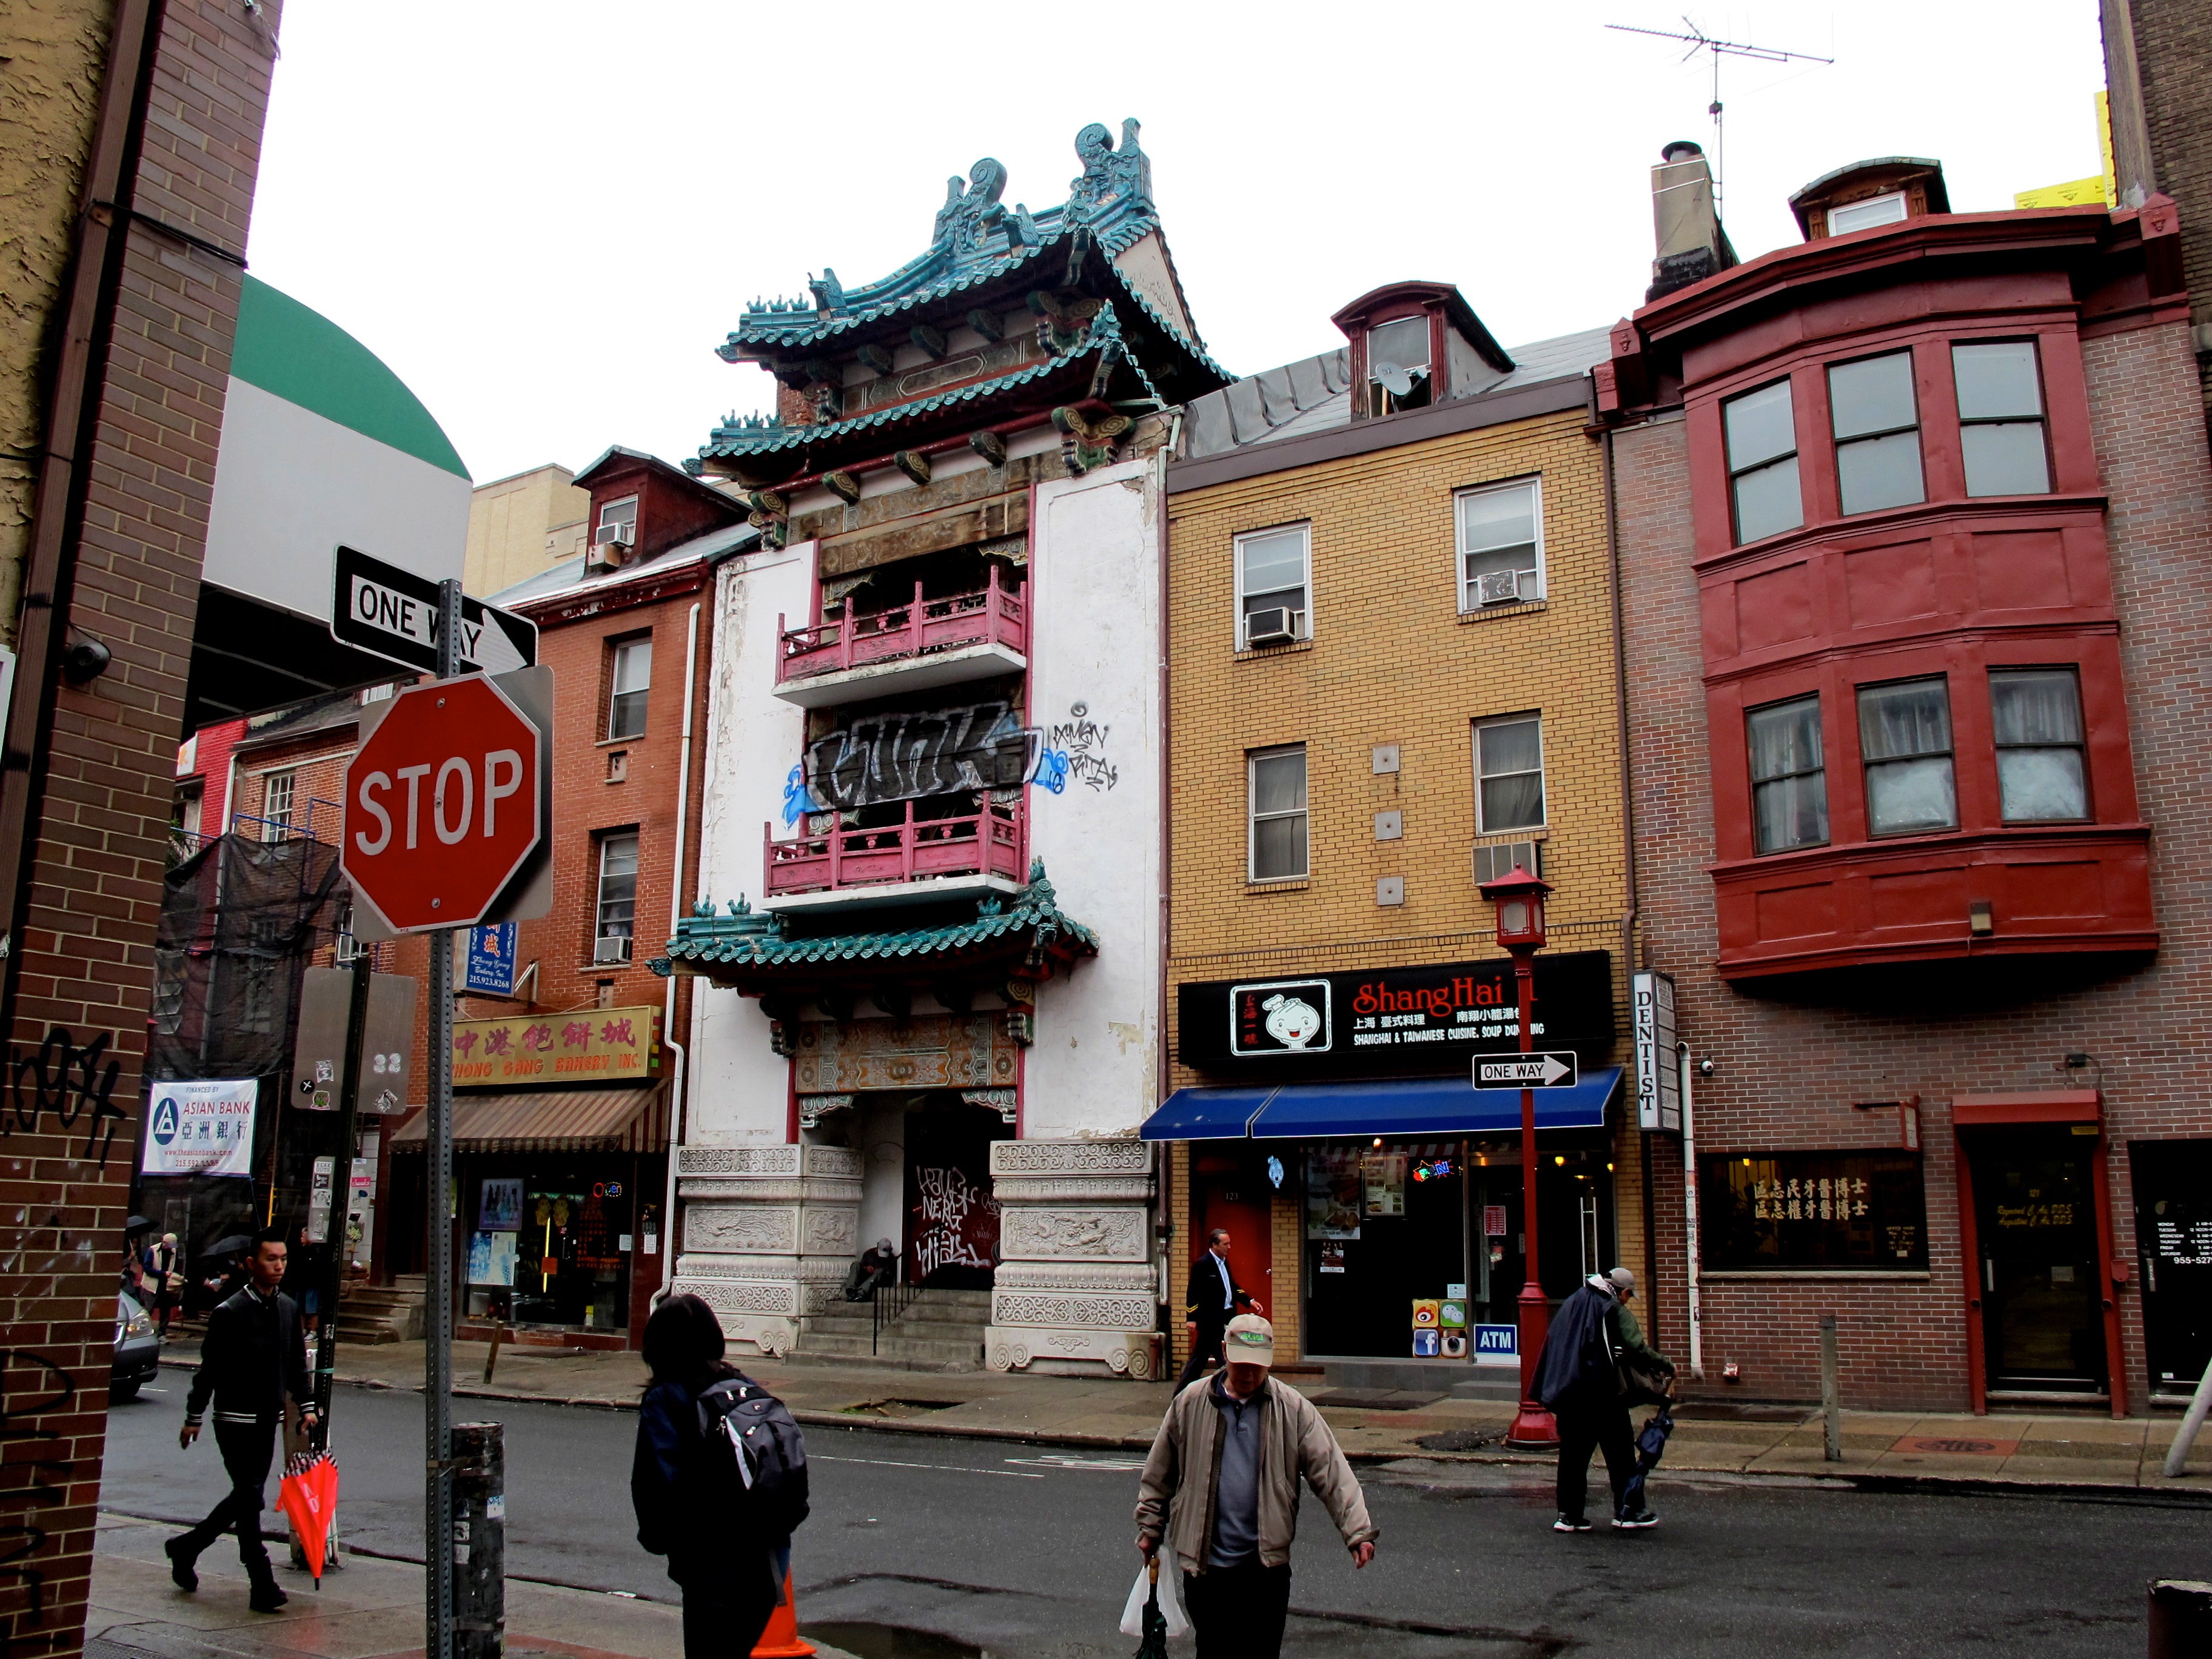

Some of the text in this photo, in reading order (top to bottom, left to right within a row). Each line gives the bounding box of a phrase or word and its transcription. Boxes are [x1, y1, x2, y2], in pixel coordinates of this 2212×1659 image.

[359, 584, 483, 659] ONE WY
[355, 748, 523, 856] STOP
[469, 974, 510, 988] 215.923.8268
[1353, 976, 1504, 1017] ShangHai
[1353, 1017, 1376, 1030] 上海
[1353, 1032, 1392, 1046] SHANGHAI
[1394, 1032, 1401, 1043] &
[1403, 1029, 1446, 1043] TAIWANESE
[1481, 1025, 1503, 1038] SOUP
[1637, 991, 1655, 1111] DENTIST
[452, 1053, 642, 1078] HONG GANG BAKERY INC.
[1484, 1064, 1544, 1079] ONE WAY
[183, 1101, 250, 1115] ASIAN BANK
[183, 1120, 248, 1140] 亞洲銀行
[1226, 1192, 1238, 1201] 123
[1480, 1331, 1512, 1349] ATM
